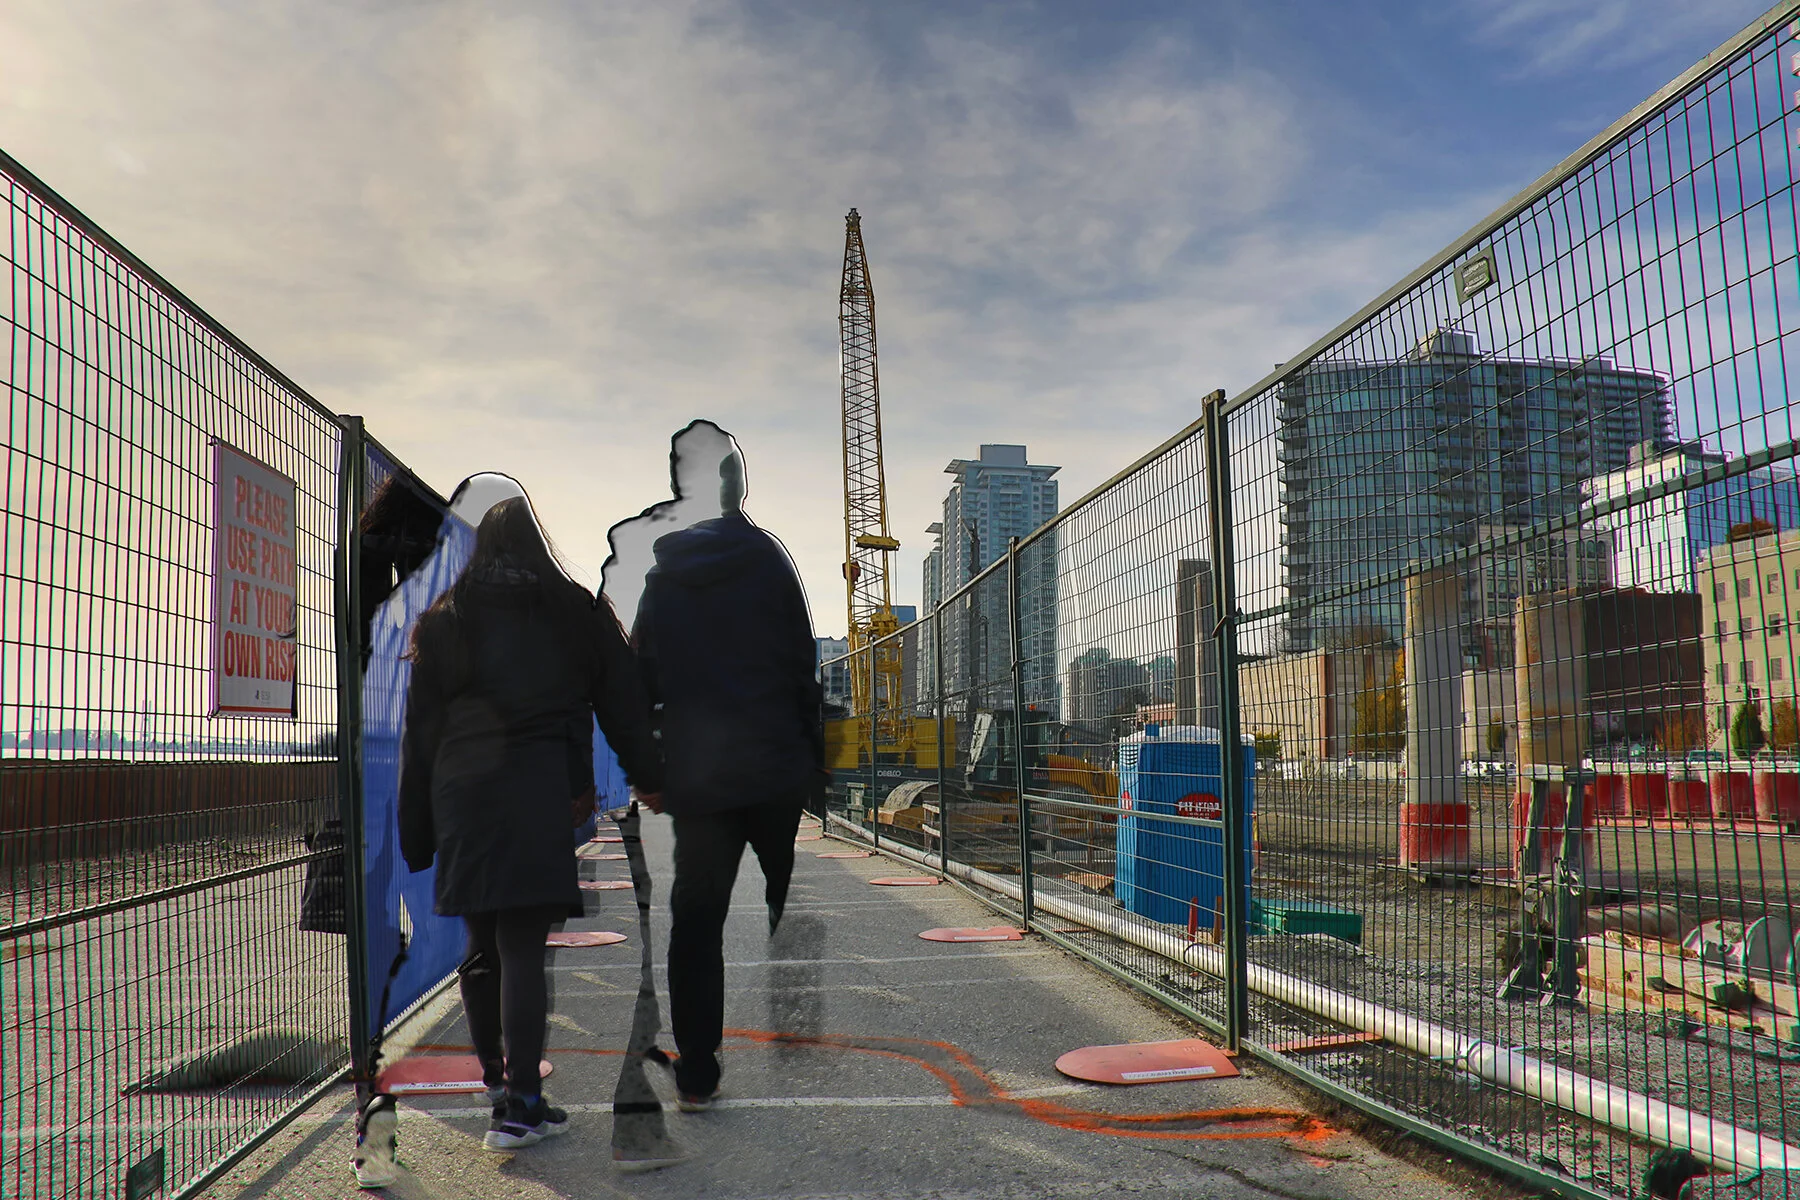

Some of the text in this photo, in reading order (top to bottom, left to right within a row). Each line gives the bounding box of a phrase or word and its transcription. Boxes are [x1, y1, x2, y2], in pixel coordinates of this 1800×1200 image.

[236, 475, 288, 538] PLEASE
[226, 523, 295, 588] USE PATH
[230, 579, 292, 634] AT YOUR
[224, 630, 296, 682] OWN RISK
